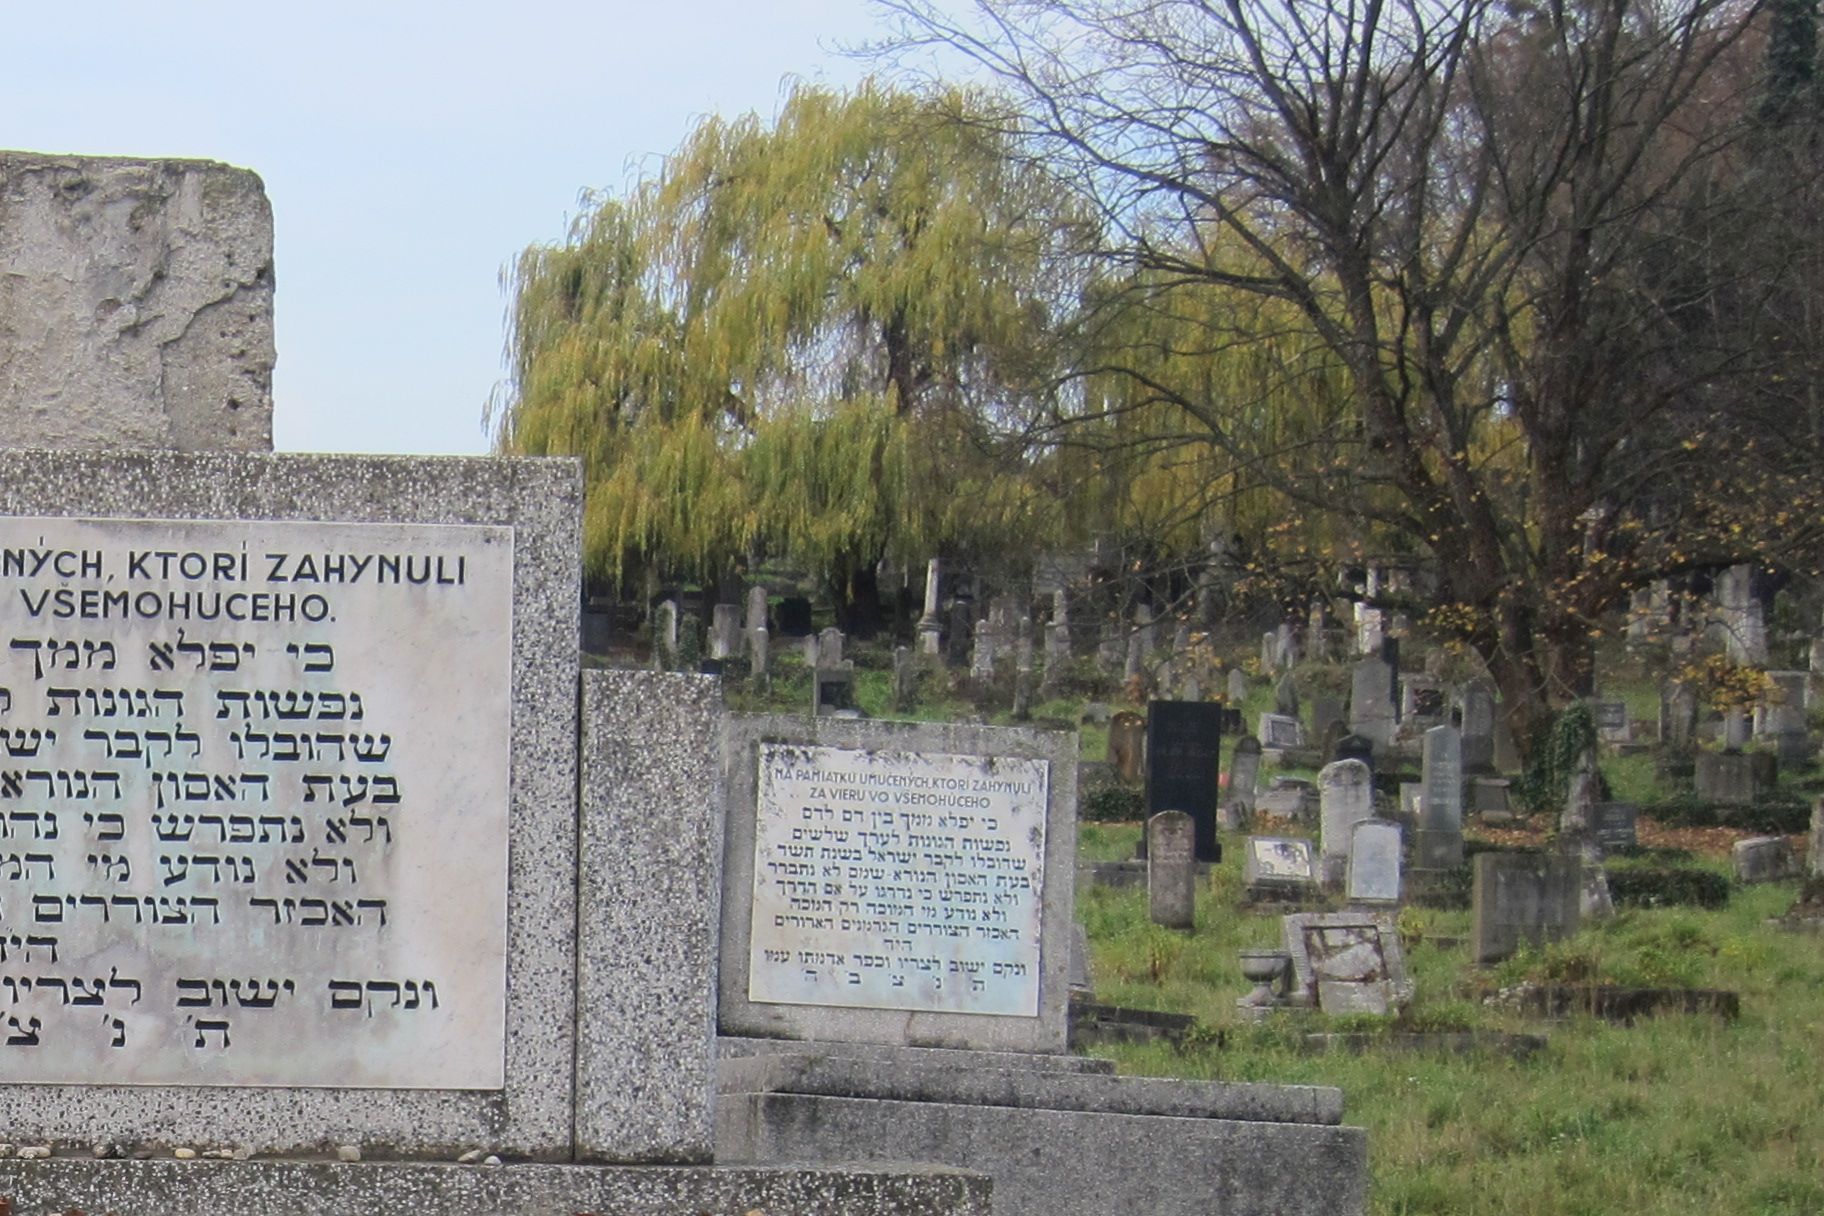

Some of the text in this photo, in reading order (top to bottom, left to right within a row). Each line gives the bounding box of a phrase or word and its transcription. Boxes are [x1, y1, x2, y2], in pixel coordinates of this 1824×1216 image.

[128, 541, 247, 582] KTORÍ
[266, 554, 465, 585] ZAHYNULI
[10, 639, 116, 680] ממך
[149, 628, 255, 671] יפלא
[287, 645, 334, 671] כי
[47, 687, 183, 717] הגונות
[217, 690, 363, 719] נפשות
[83, 723, 201, 768] לקבר
[230, 723, 392, 762] שהובלו
[0, 769, 120, 800] הנורא
[151, 772, 269, 808] האסון
[302, 775, 402, 804] בעת
[775, 769, 792, 780] NA
[796, 769, 856, 784] PAMIATKU
[973, 780, 1031, 794] ZAHYNULI
[810, 788, 825, 799] ZA
[830, 789, 865, 801] VIERU
[869, 792, 889, 803] VO
[83, 812, 125, 840] כי
[151, 813, 305, 842] נתפרש
[326, 808, 392, 843] ולא
[86, 854, 130, 882] מי
[160, 855, 255, 886] נודע
[285, 848, 356, 883] ולא
[33, 895, 219, 925] הצוררים
[250, 897, 387, 926] האכזר
[3, 966, 141, 1006] לצריו
[176, 979, 295, 1008] ישוב
[328, 980, 438, 1018] ונקם
